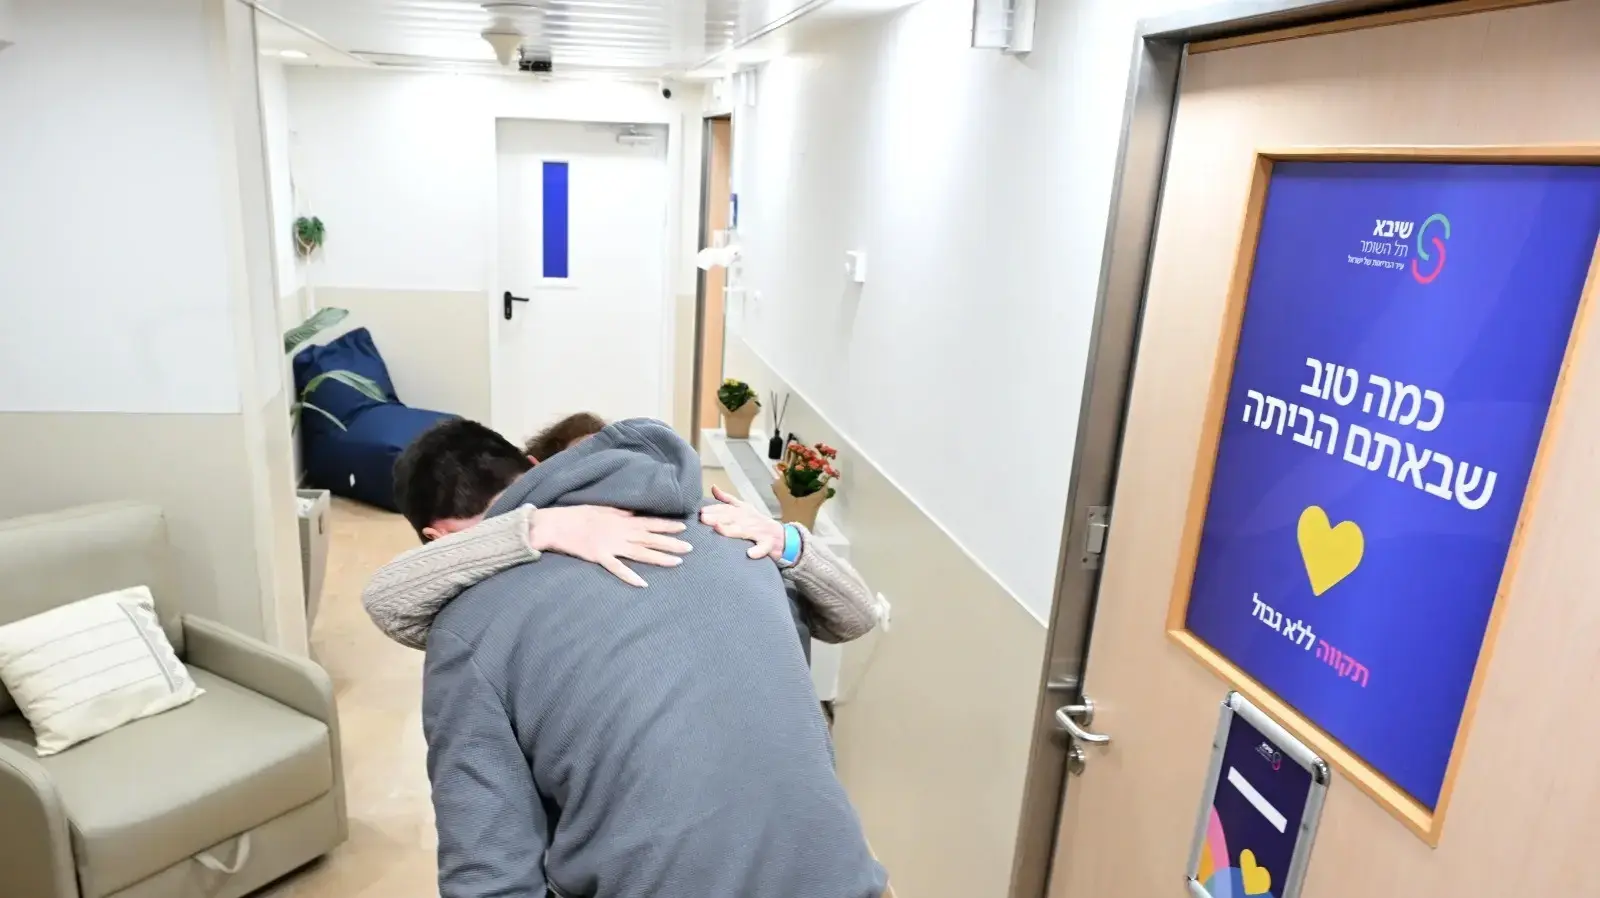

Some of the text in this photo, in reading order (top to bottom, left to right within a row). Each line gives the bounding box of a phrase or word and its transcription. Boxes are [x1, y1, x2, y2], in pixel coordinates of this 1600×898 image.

[1360, 240, 1408, 258] תל השומר
[1373, 219, 1414, 239] שיבא
[1300, 356, 1445, 432] כמה טוב
[1242, 389, 1498, 510] שבאתם הביתה
[1251, 592, 1370, 688] תקווה ללא גבול
